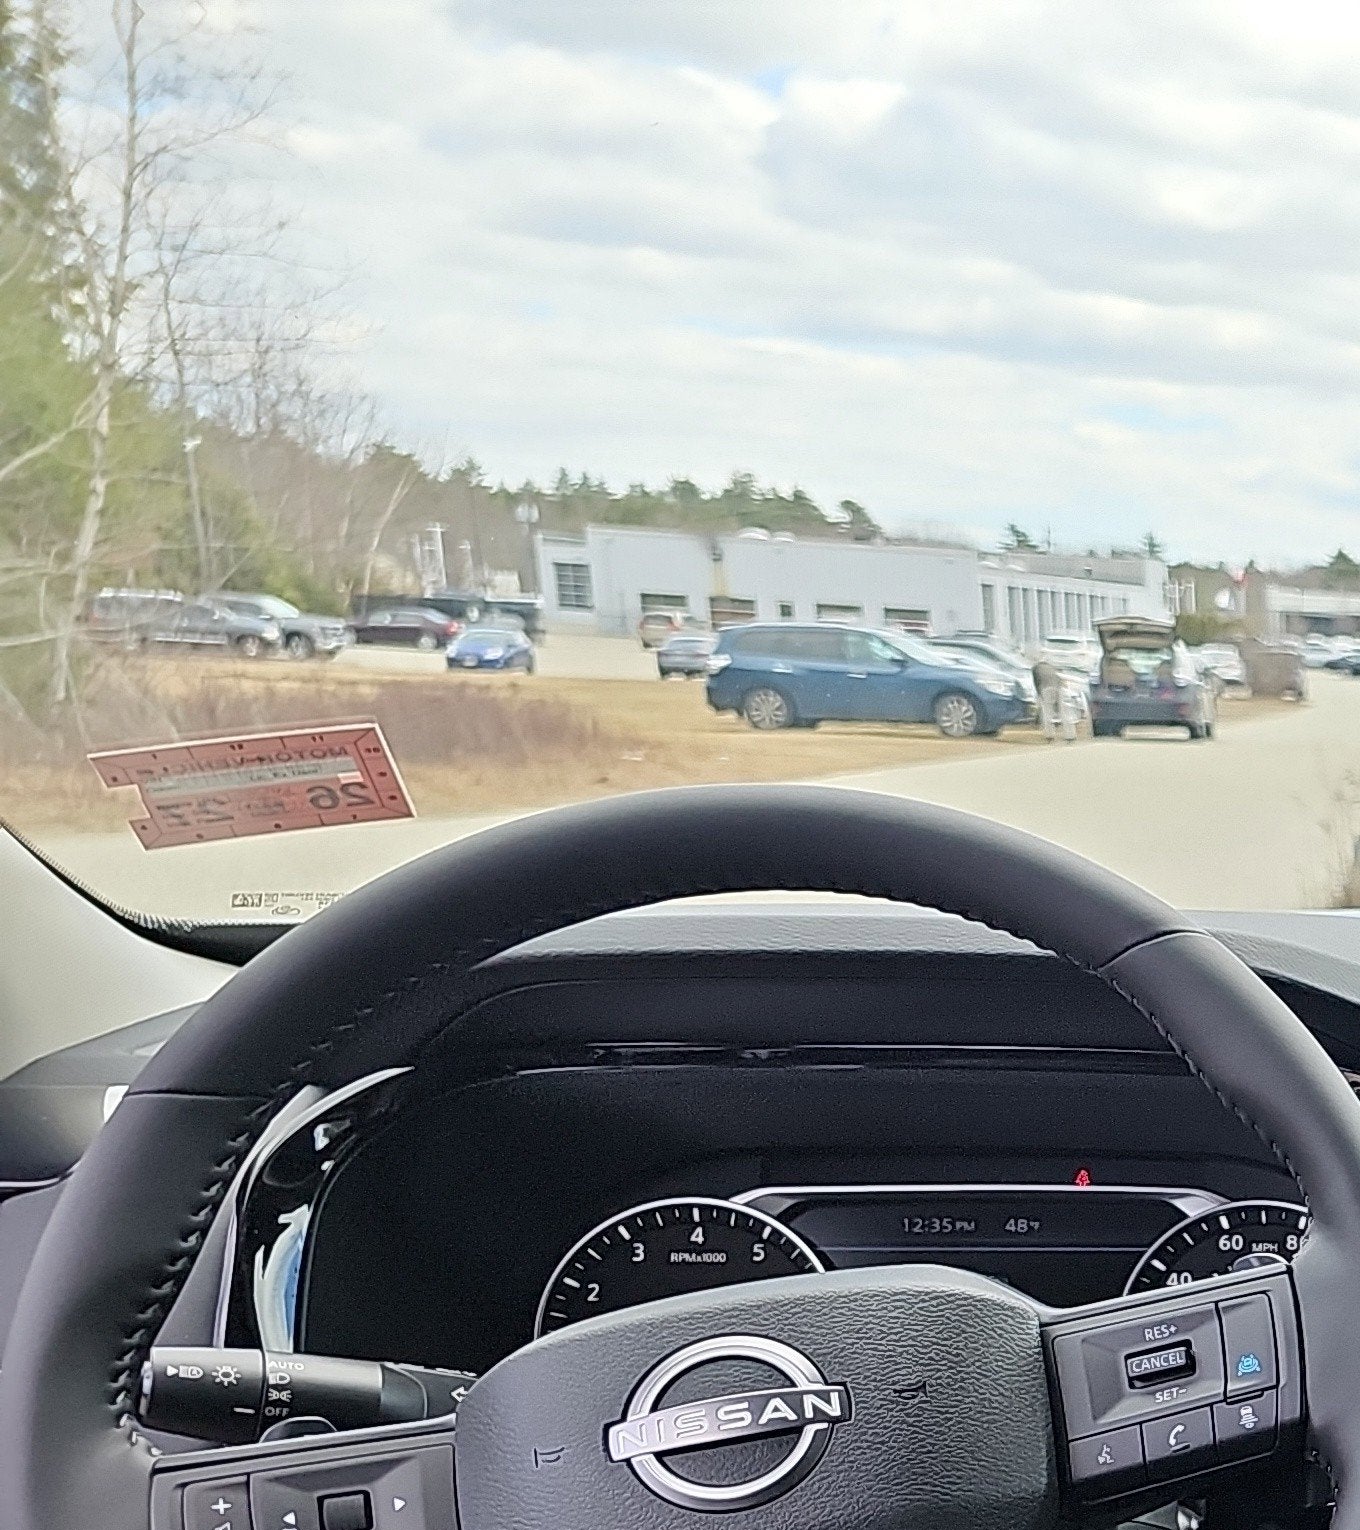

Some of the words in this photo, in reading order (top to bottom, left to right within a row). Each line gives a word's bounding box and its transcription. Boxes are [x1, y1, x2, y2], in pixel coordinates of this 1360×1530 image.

[903, 1218, 953, 1233] 12:35
[689, 1226, 705, 1245] 4
[1218, 1234, 1244, 1251] 60
[632, 1242, 646, 1262] 3
[752, 1243, 766, 1262] 5
[1251, 1242, 1279, 1252] MPH
[1166, 1272, 1193, 1286] 40
[587, 1283, 600, 1302] 2
[1143, 1323, 1178, 1341] RES+
[267, 1360, 305, 1371] AUTO
[1131, 1348, 1186, 1374] CANCEL
[264, 1406, 290, 1417] OFF
[616, 1391, 842, 1456] NISSAN
